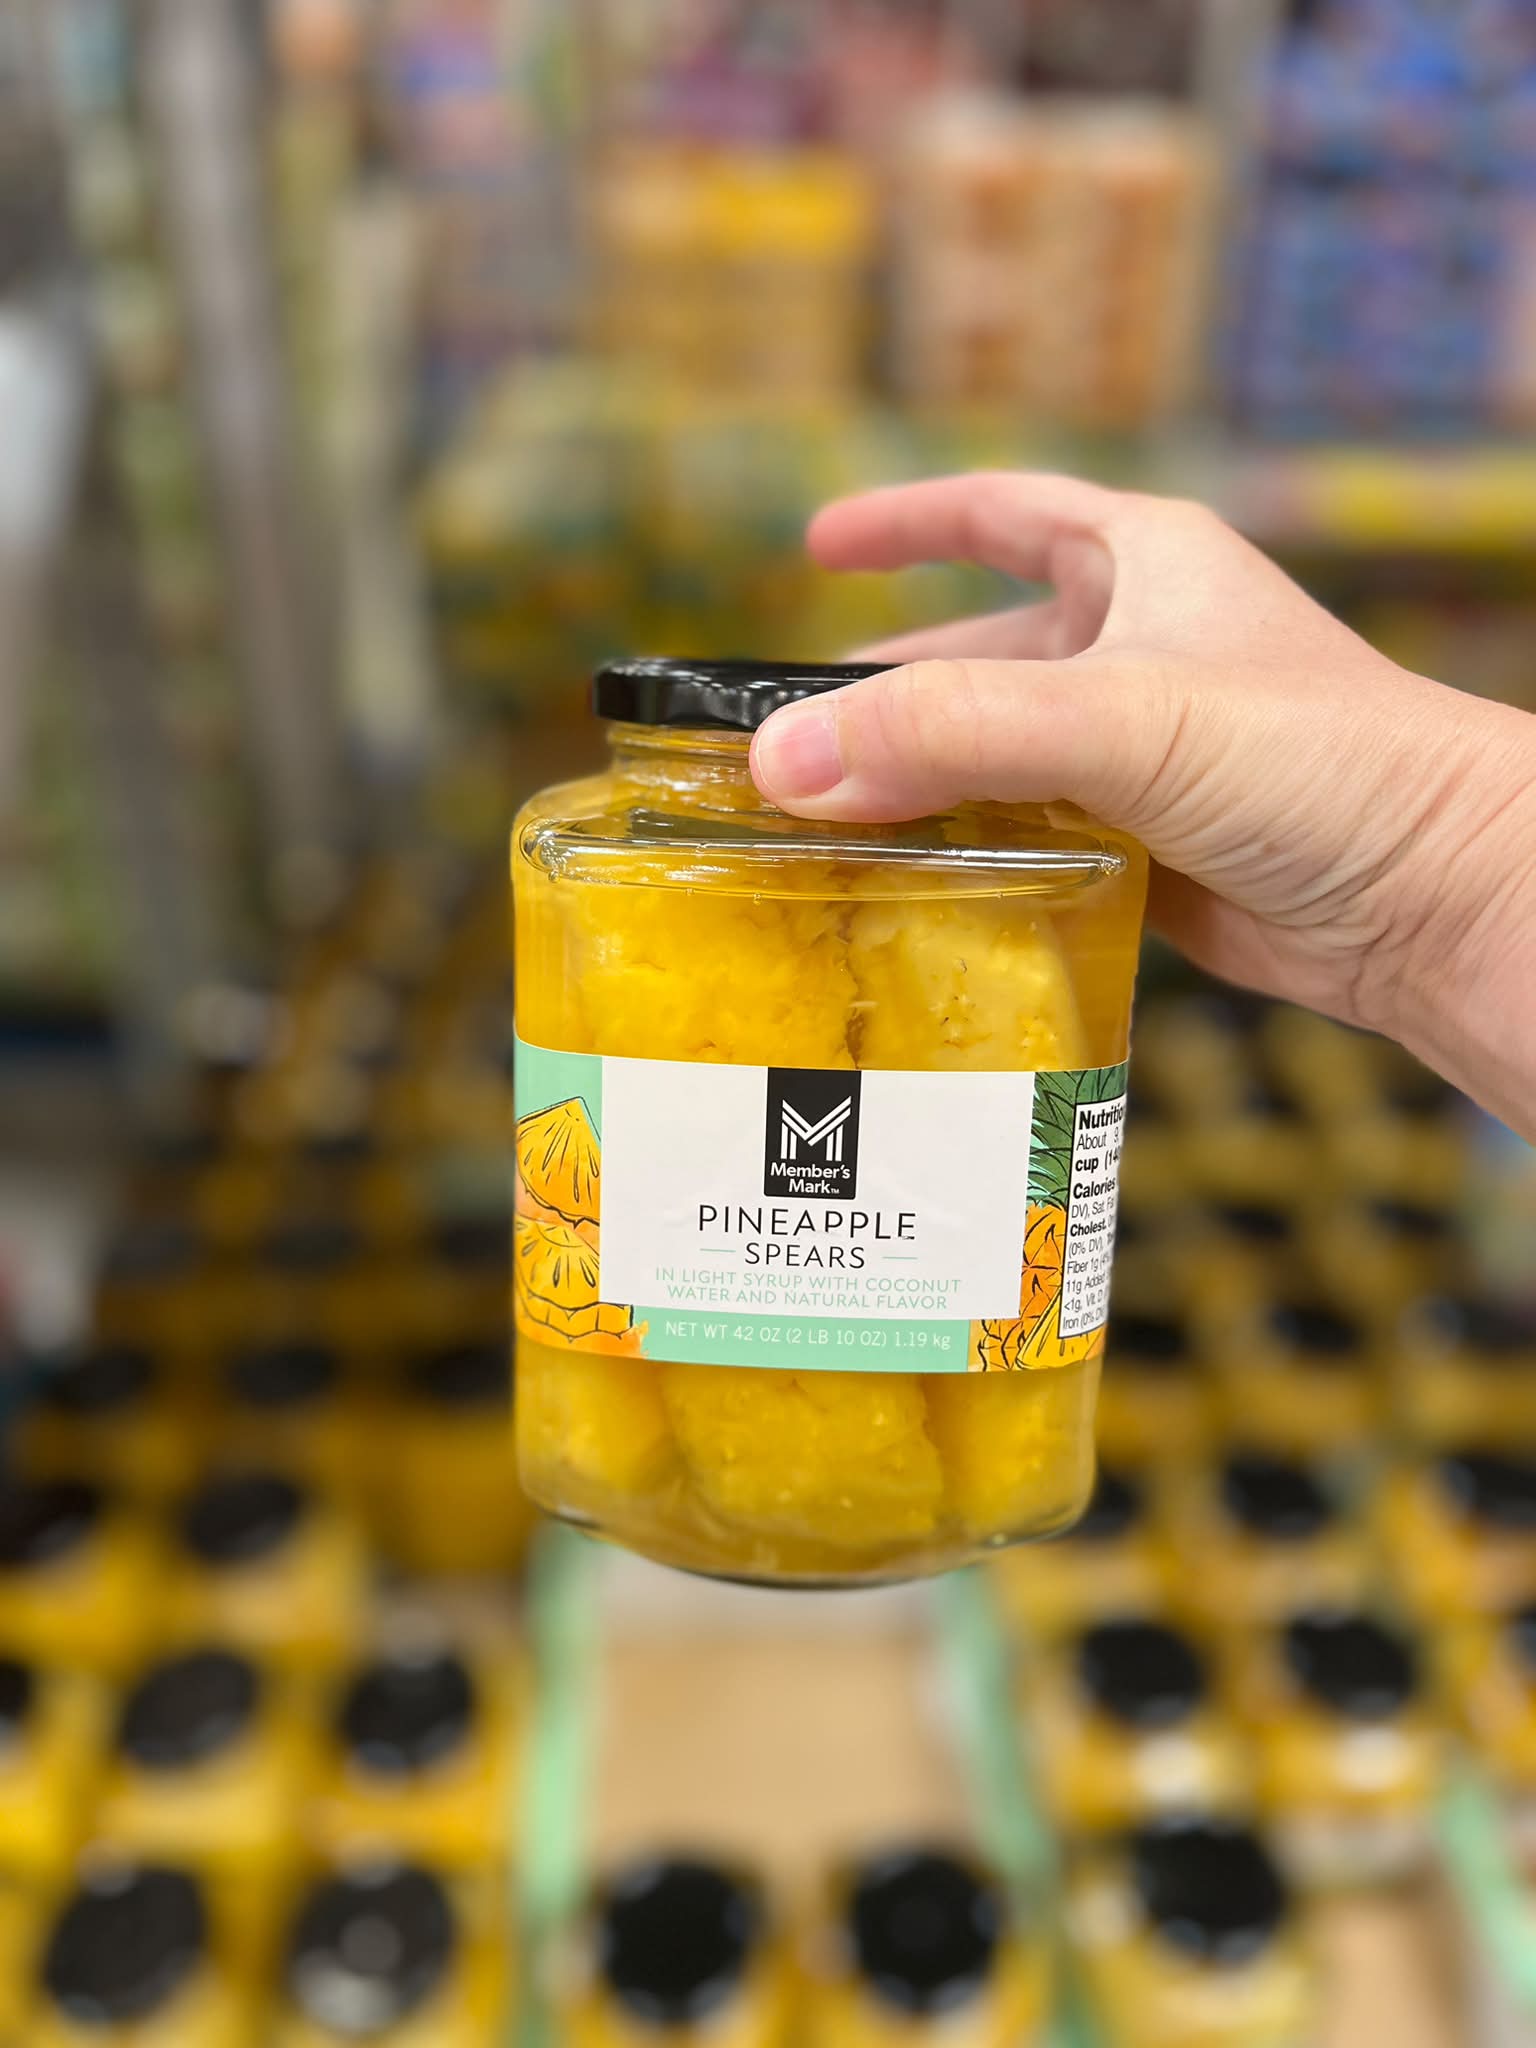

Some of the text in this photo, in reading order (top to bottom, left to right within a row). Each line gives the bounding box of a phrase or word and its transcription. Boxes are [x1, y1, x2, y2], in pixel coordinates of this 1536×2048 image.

[1076, 1131, 1107, 1151] About
[770, 1162, 850, 1179] Member's
[1075, 1157, 1099, 1173] cup
[1073, 1177, 1116, 1199] Calories
[699, 1205, 916, 1240] PINEAPPLE
[745, 1243, 865, 1269] SPEARS
[1068, 1241, 1086, 1258] (0%
[1067, 1260, 1088, 1275] Fiber
[1090, 1257, 1099, 1272] 1g
[656, 1268, 961, 1293] IN LIGHT SYRUP WITH COCONUT
[1066, 1280, 1082, 1295] 11g
[667, 1285, 947, 1309] WATER AND NATURAL FLAVOR
[1063, 1316, 1080, 1330] Iron
[665, 1321, 951, 1350] NET WT 42 OZ (2 LB 10 OZ) 1.19 kg
